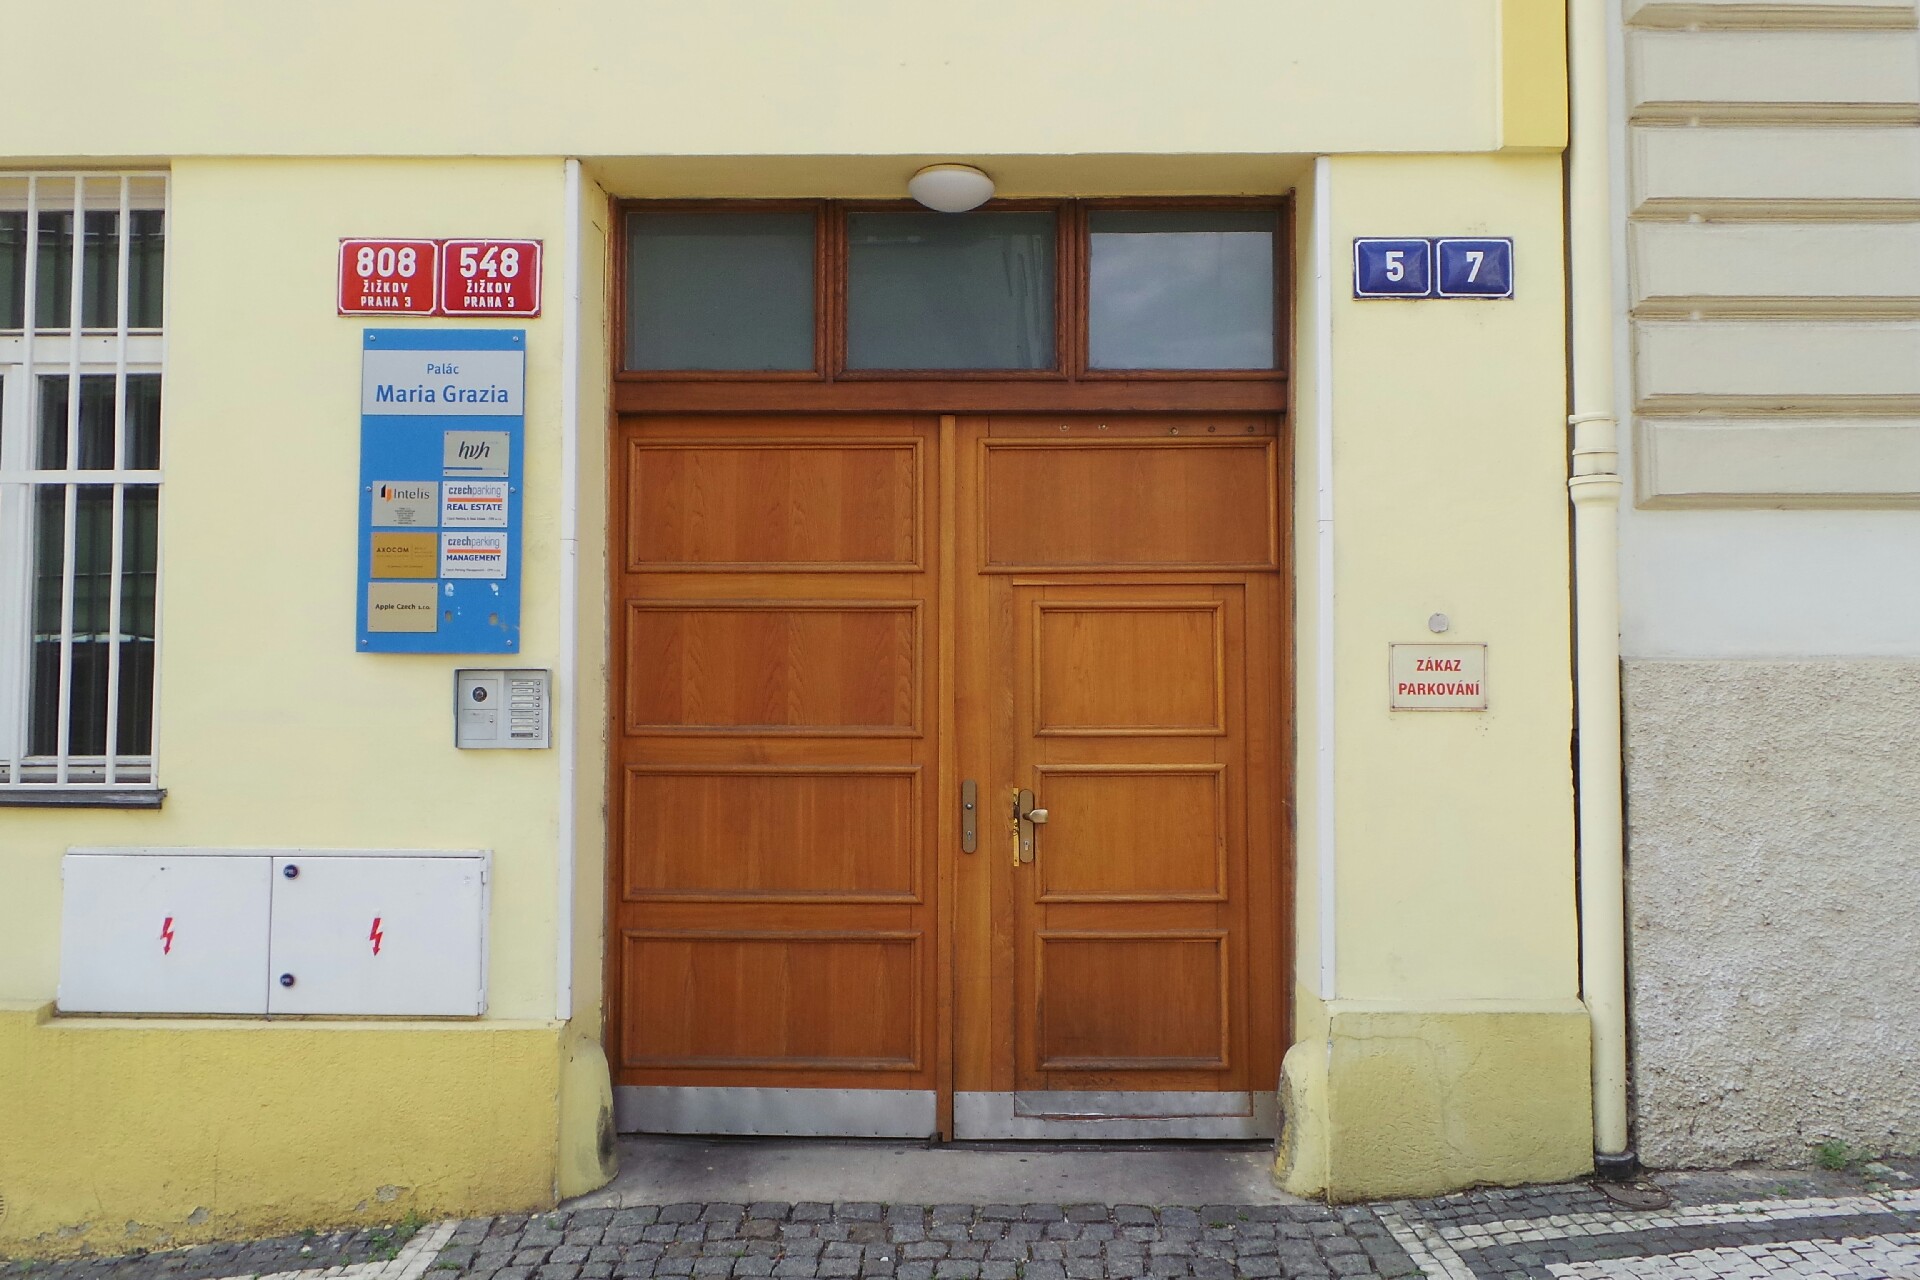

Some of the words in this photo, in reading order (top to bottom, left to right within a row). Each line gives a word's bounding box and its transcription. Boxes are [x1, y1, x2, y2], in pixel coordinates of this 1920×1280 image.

[356, 246, 416, 278] 808
[459, 245, 519, 278] 548
[1385, 251, 1404, 282] 5
[1466, 251, 1484, 283] 7
[362, 279, 409, 293] ŽIŽKOV
[466, 279, 512, 294] ŽIŽKOV
[360, 296, 399, 307] PRAHA
[404, 296, 412, 307] 3
[464, 296, 502, 308] PRAHA
[507, 296, 515, 308] 3
[426, 363, 460, 375] Palác
[376, 384, 436, 403] Maria
[442, 384, 509, 403] Grazia
[458, 440, 491, 460] hvh
[394, 487, 430, 500] Intelis
[448, 484, 502, 497] czechparking
[446, 503, 469, 511] REAL
[471, 503, 503, 511] ESTATE
[447, 535, 500, 549] czechparking
[446, 554, 502, 562] MANAGEMENT
[375, 603, 395, 611] Apple
[1416, 656, 1462, 672] ZÁKAZ
[1398, 679, 1480, 696] PARKOVÁNÍ
